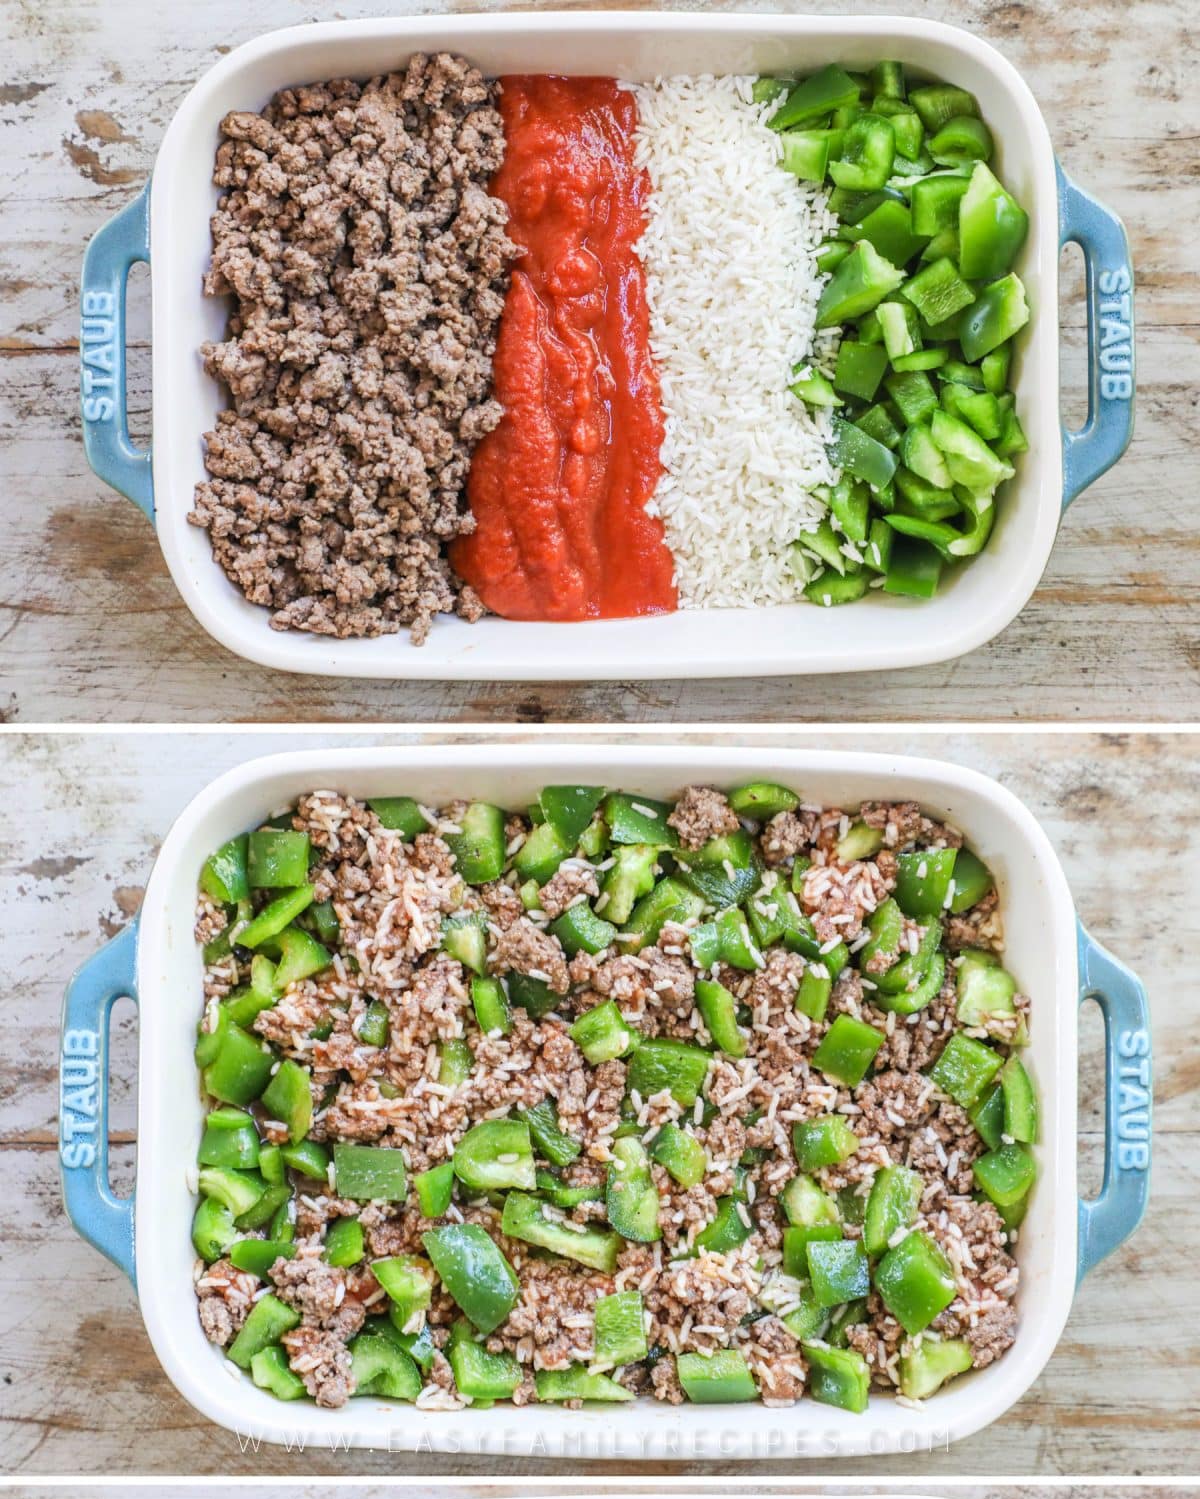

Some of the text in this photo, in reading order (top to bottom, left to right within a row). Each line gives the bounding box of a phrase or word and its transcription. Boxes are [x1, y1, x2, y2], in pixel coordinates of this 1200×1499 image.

[83, 290, 114, 422] STAUB
[1099, 267, 1132, 400] STAUB
[62, 1029, 98, 1168] STAUB
[1118, 1030, 1150, 1171] STAUB
